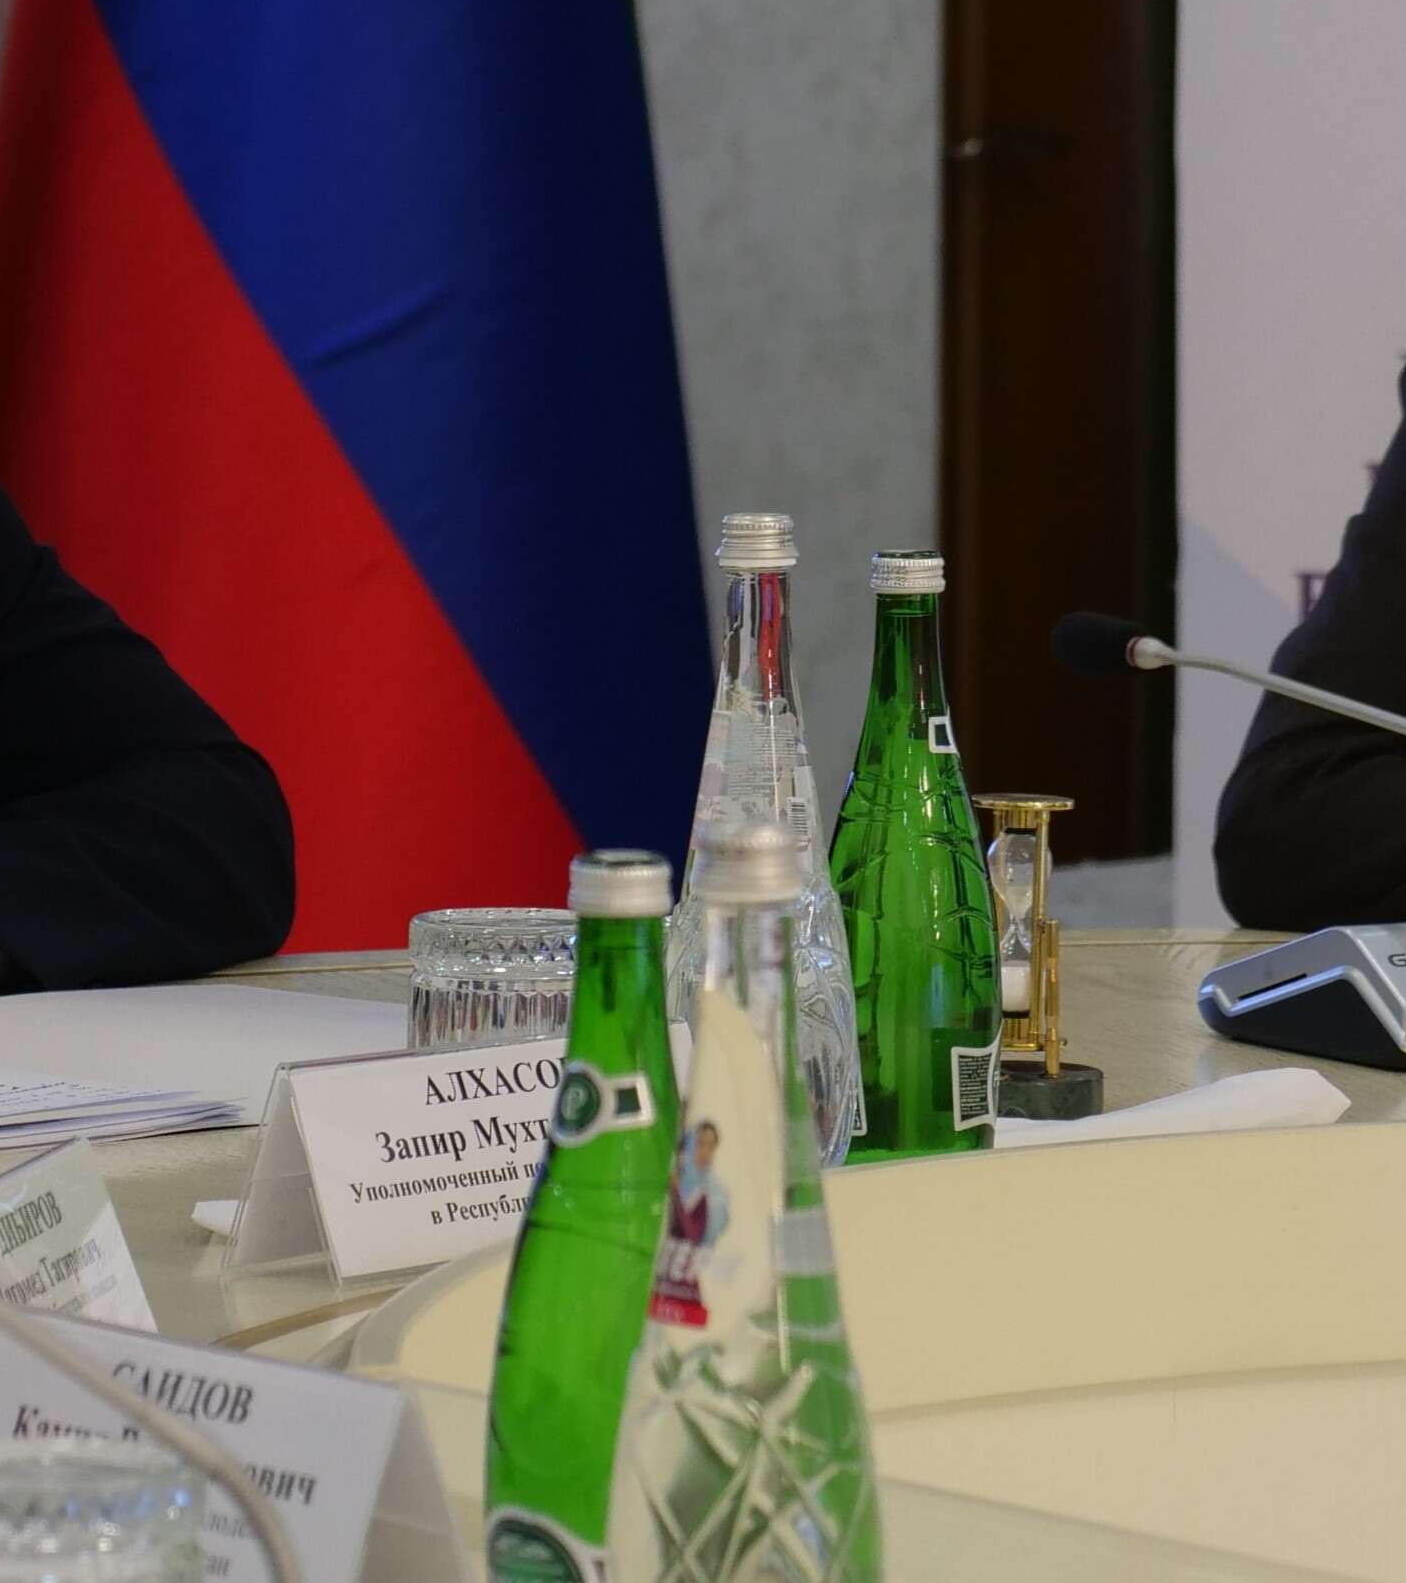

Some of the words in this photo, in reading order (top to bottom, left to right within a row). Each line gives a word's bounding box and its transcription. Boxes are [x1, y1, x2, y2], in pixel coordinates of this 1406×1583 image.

[424, 1056, 569, 1106] АЛХАСО
[375, 1129, 467, 1163] Запир
[470, 1116, 550, 1154] Мухт
[349, 1161, 520, 1204] Уполномоченный
[430, 1209, 443, 1225] в
